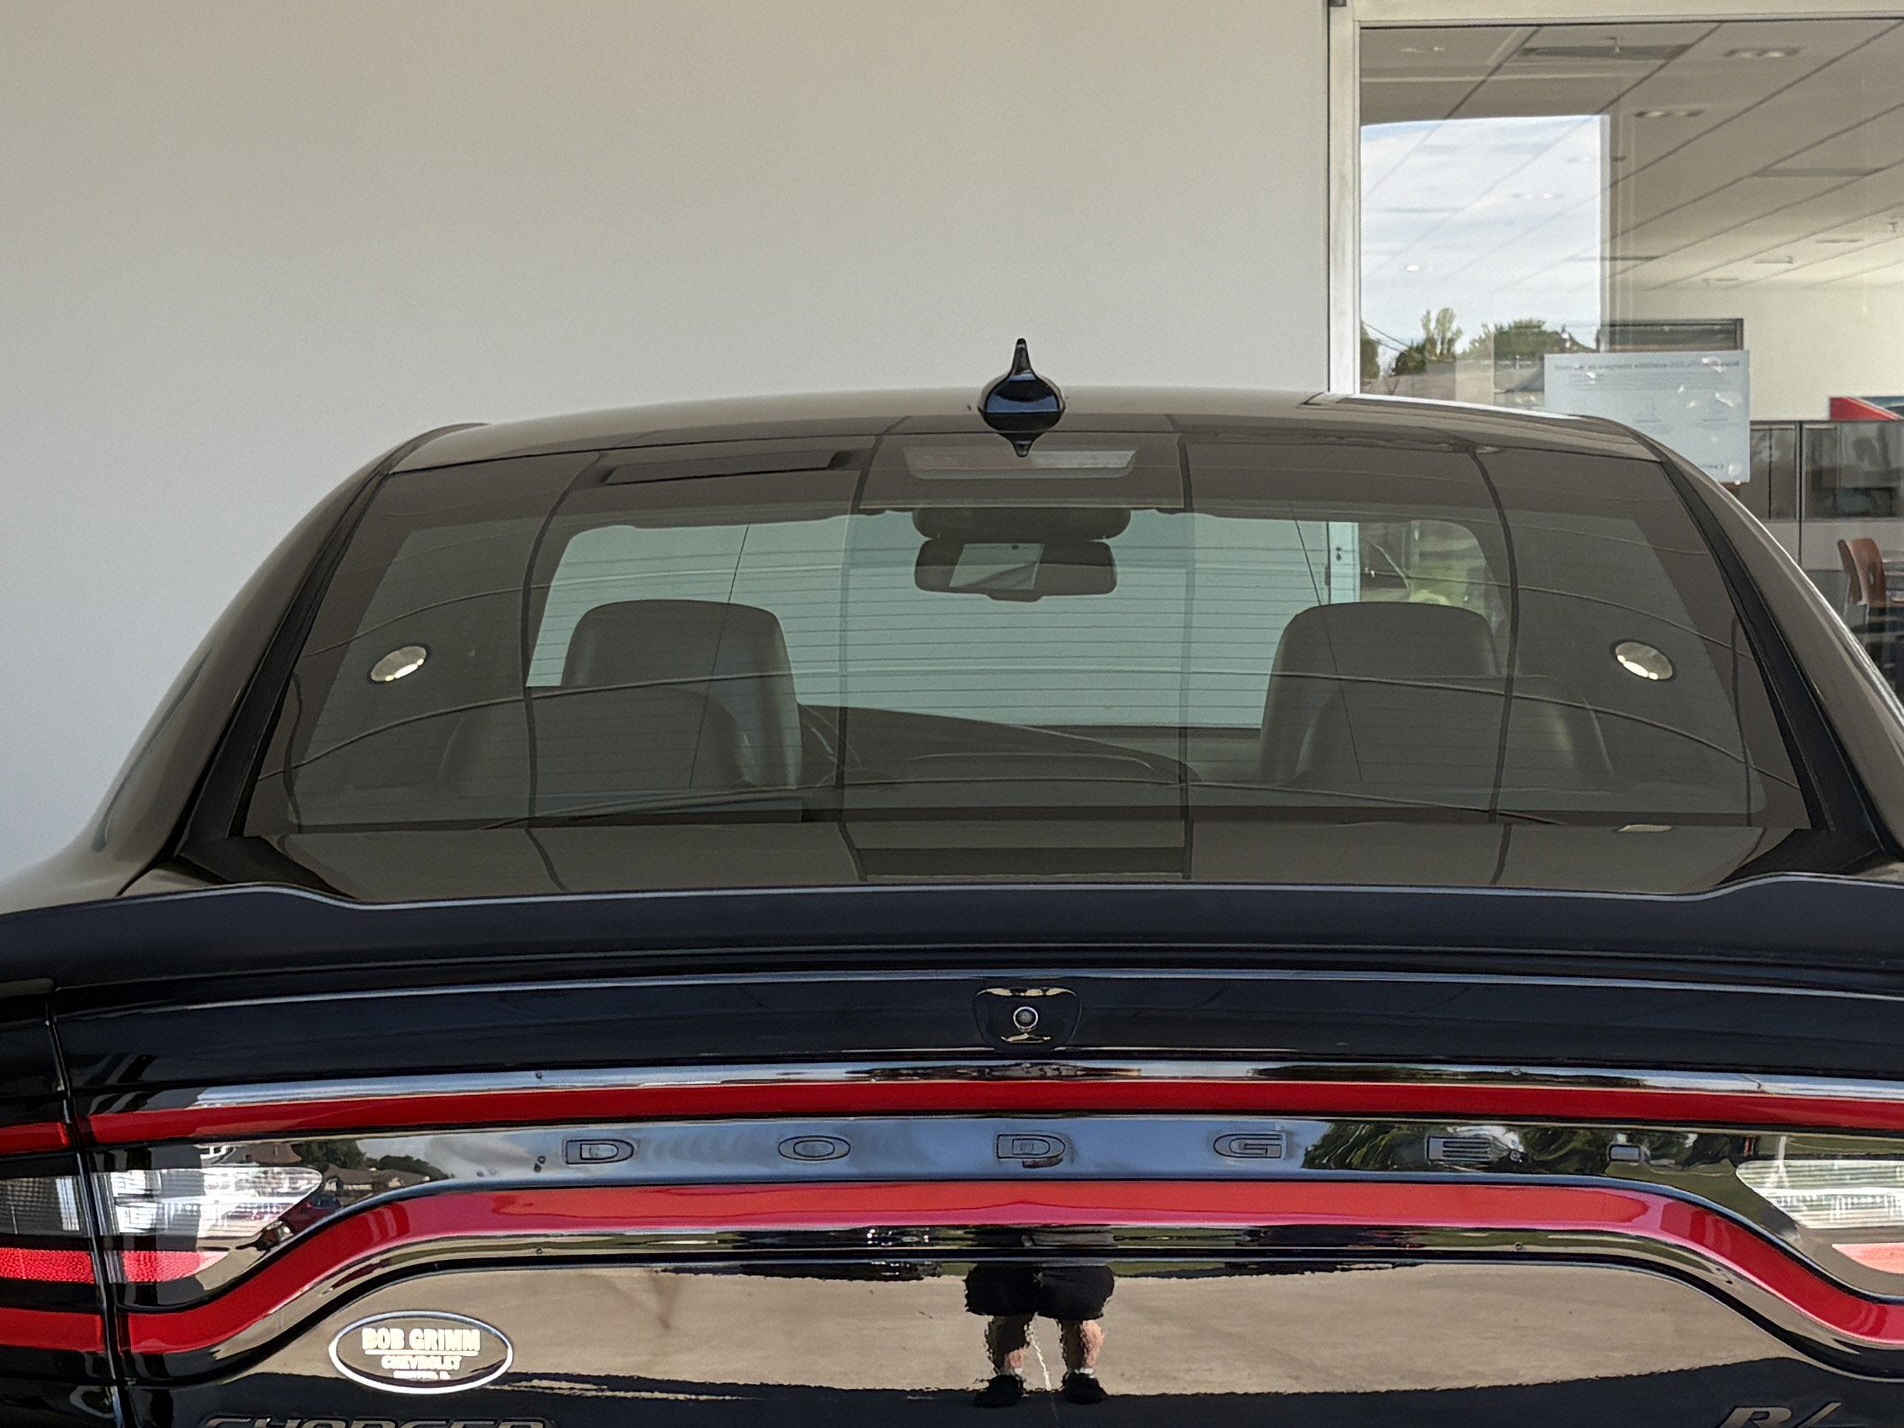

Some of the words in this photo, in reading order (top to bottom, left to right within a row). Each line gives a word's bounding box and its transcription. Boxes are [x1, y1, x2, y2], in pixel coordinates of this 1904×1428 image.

[562, 1130, 1496, 1169] DODGE
[362, 1327, 405, 1350] BOB
[409, 1327, 481, 1352] GRIMM
